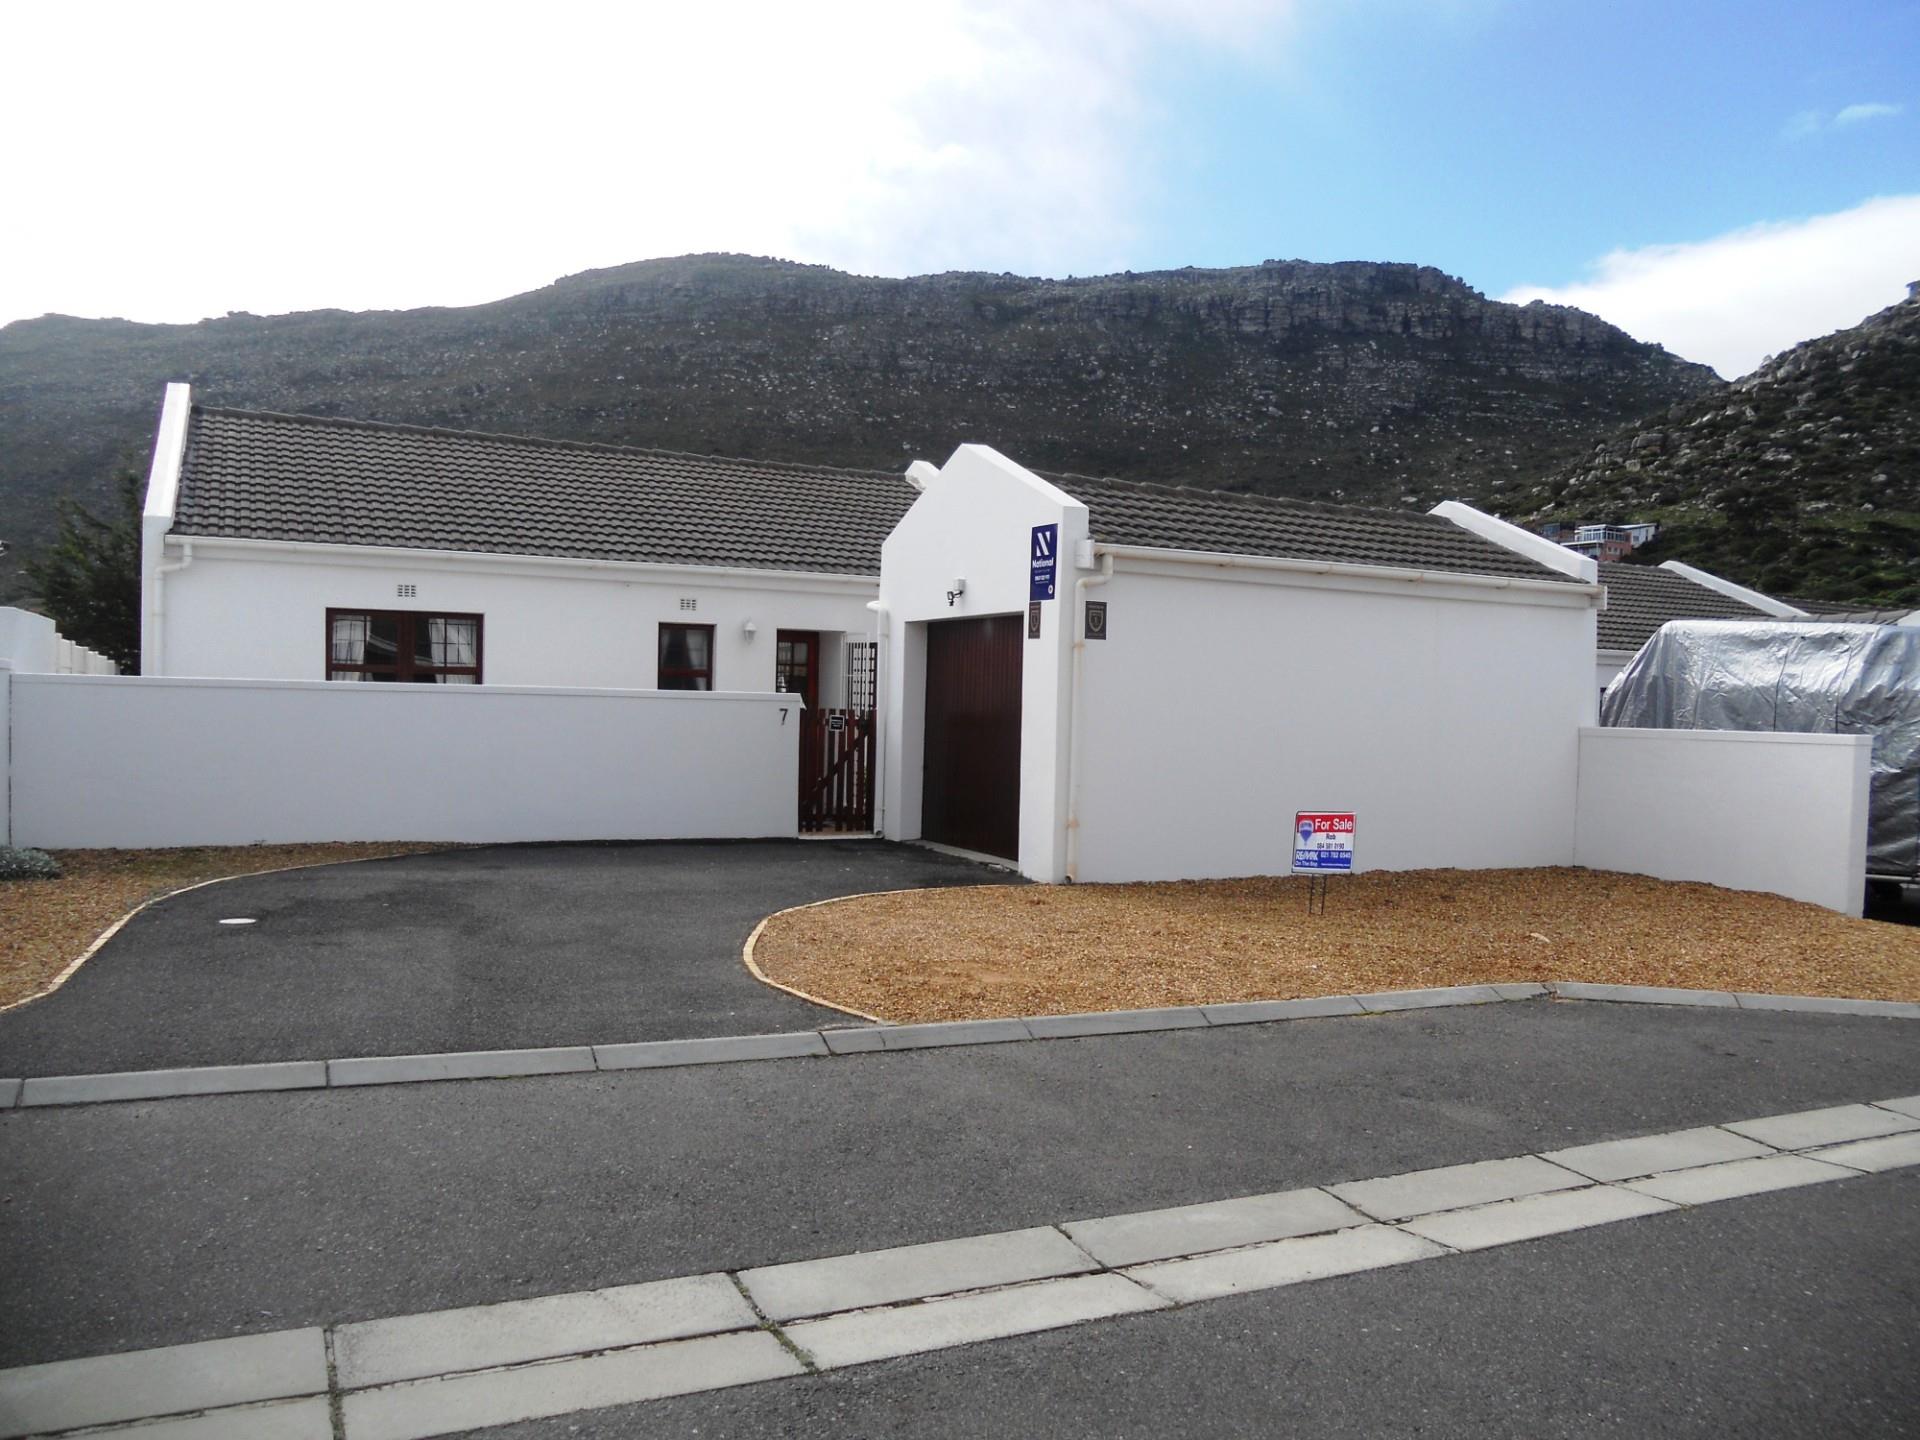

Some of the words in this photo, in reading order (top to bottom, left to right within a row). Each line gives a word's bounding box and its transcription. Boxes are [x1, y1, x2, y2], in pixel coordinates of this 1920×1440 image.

[1032, 557, 1054, 568] National
[779, 708, 788, 725] 7
[1315, 818, 1331, 830] For
[1333, 818, 1353, 830] Sale
[1296, 851, 1318, 860] RE/MAX
